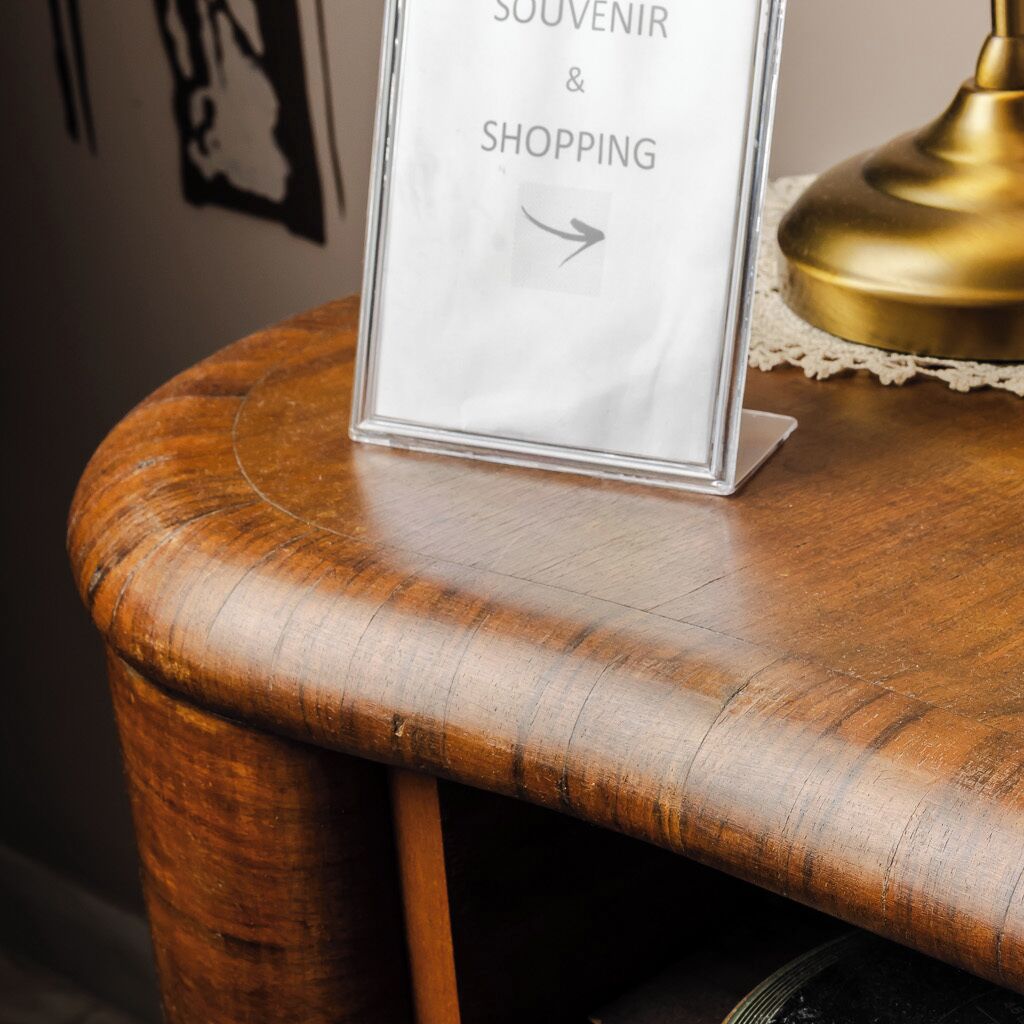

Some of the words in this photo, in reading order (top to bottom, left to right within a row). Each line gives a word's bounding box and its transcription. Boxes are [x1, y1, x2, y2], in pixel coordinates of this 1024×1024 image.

[493, 0, 669, 38] SOUVENIR
[565, 66, 585, 93] &
[480, 119, 656, 170] SHOPPING
